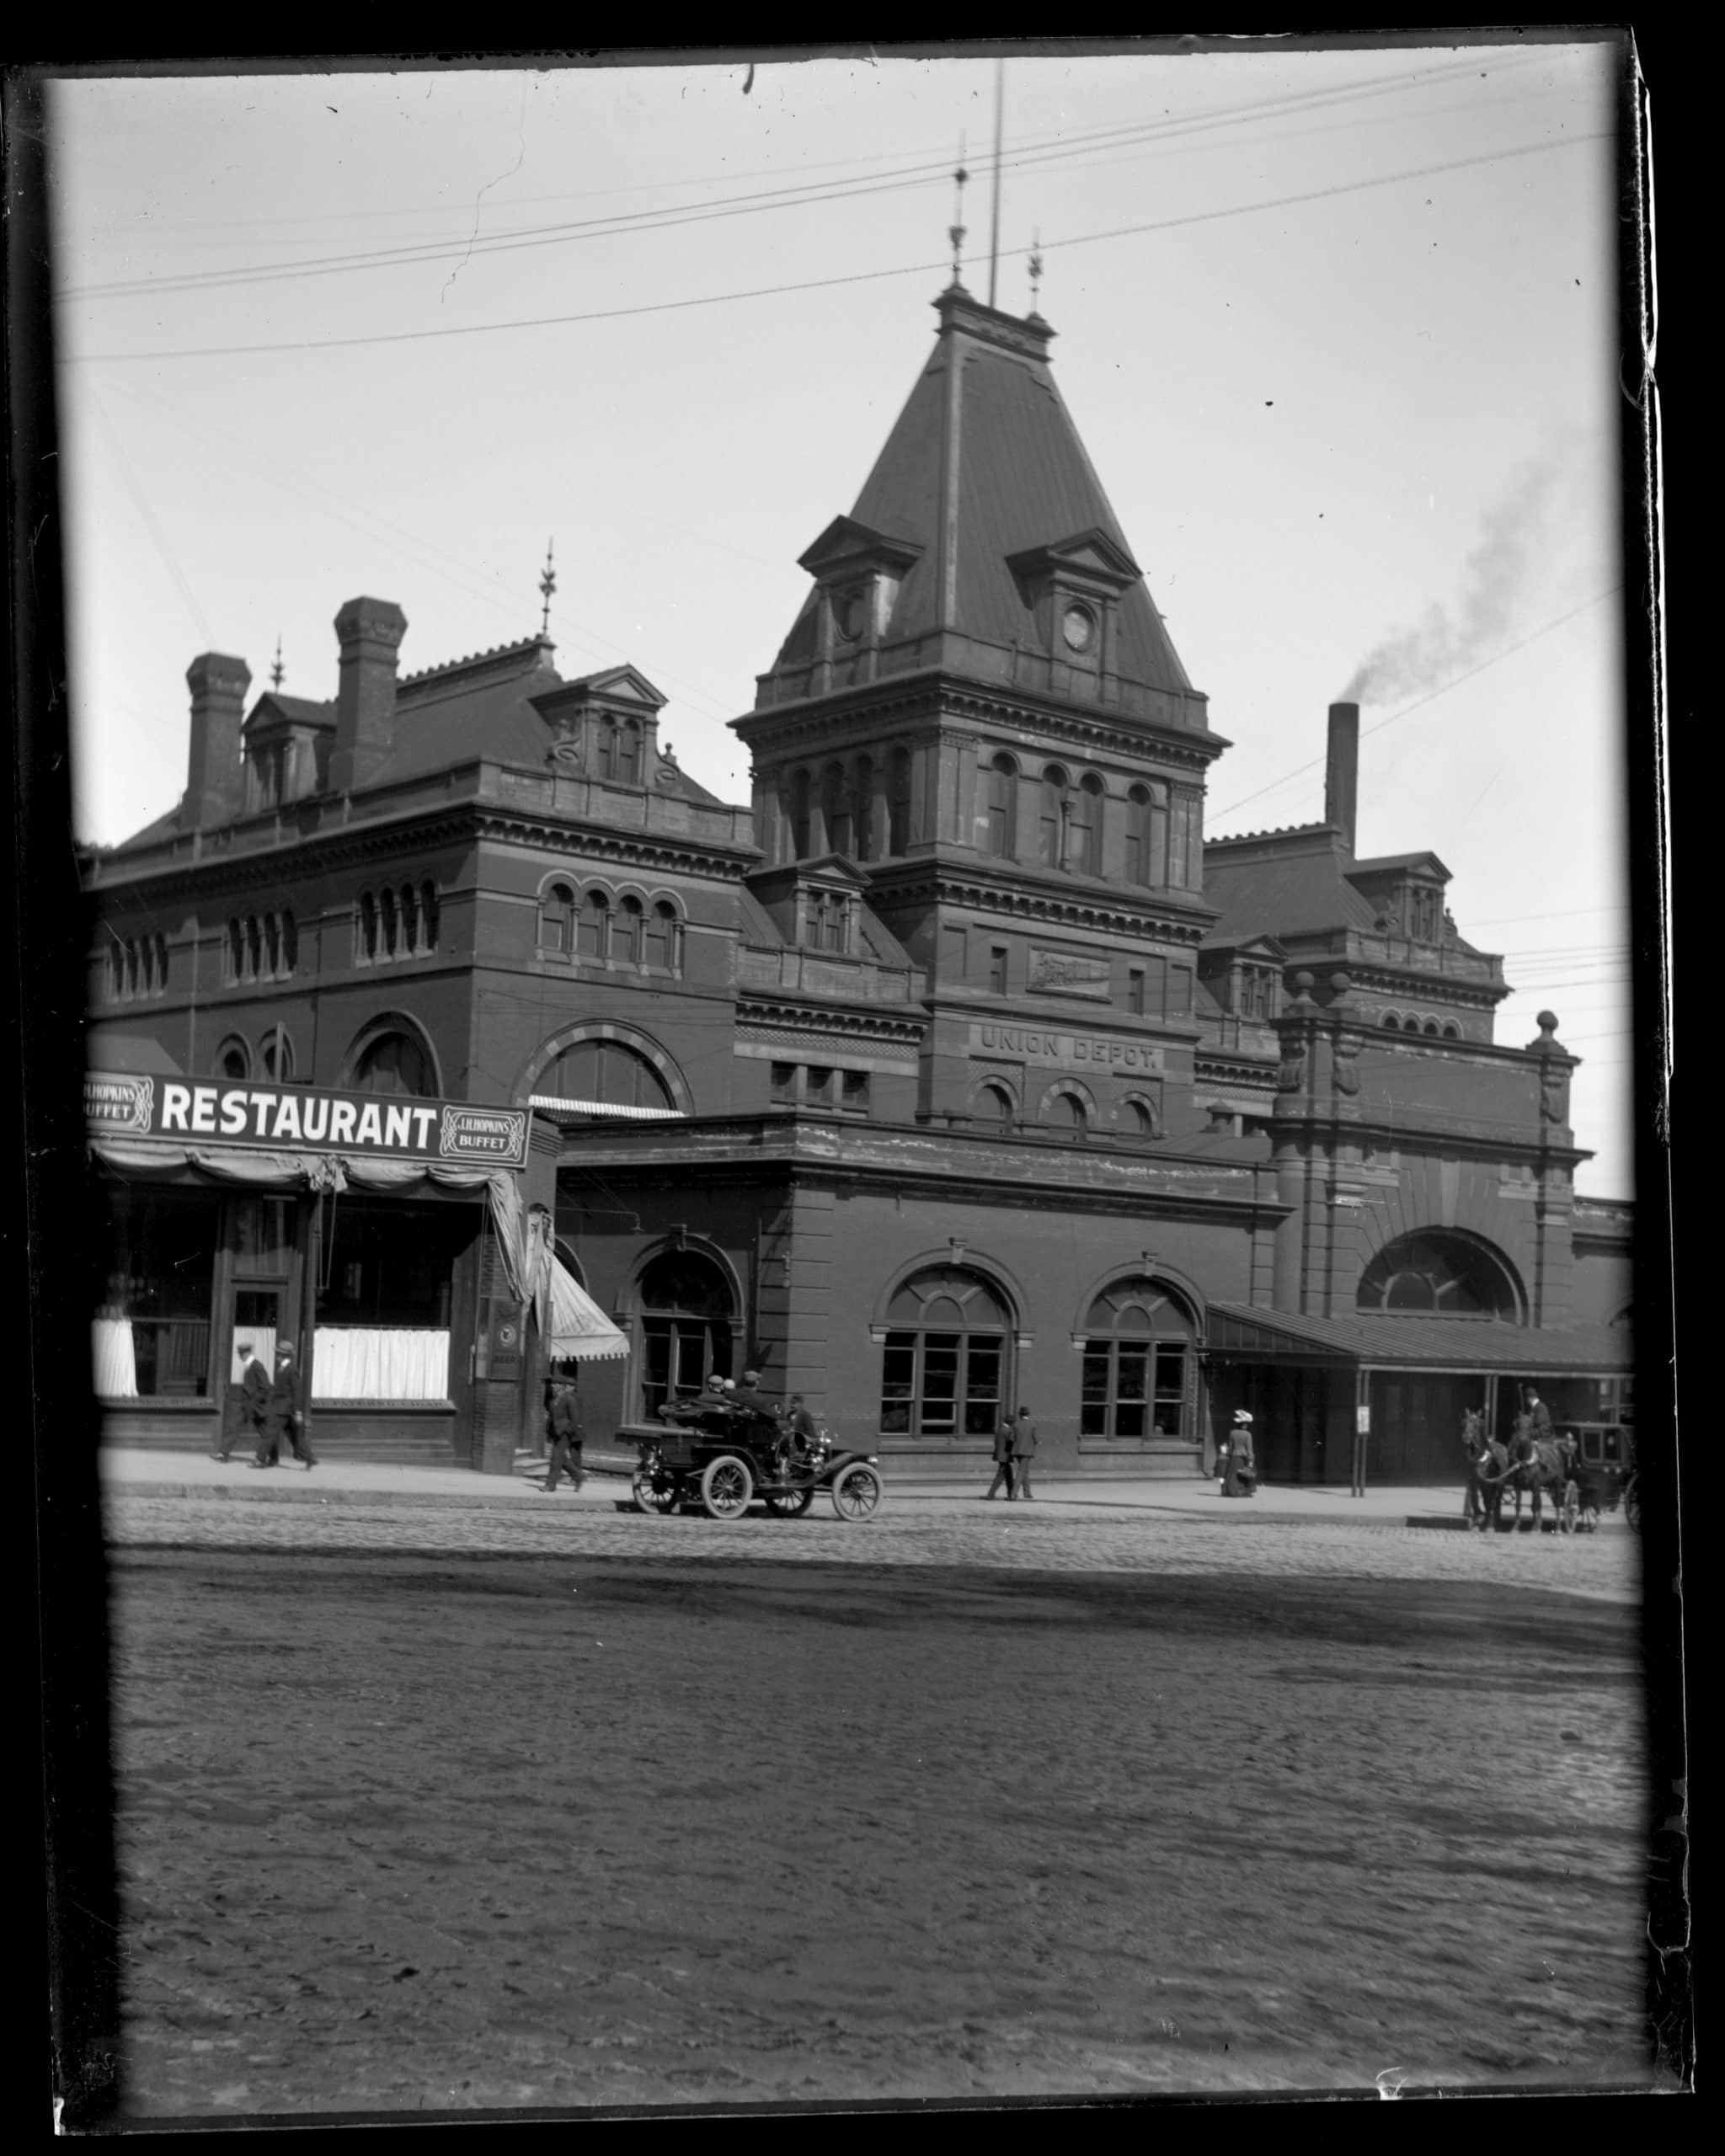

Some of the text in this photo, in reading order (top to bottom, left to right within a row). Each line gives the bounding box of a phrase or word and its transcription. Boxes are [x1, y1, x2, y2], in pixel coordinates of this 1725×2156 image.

[981, 1024, 1058, 1057] UNION
[83, 1102, 131, 1118] UFFET
[161, 1083, 437, 1150] RESTAURANT
[459, 1134, 505, 1150] BUFFET
